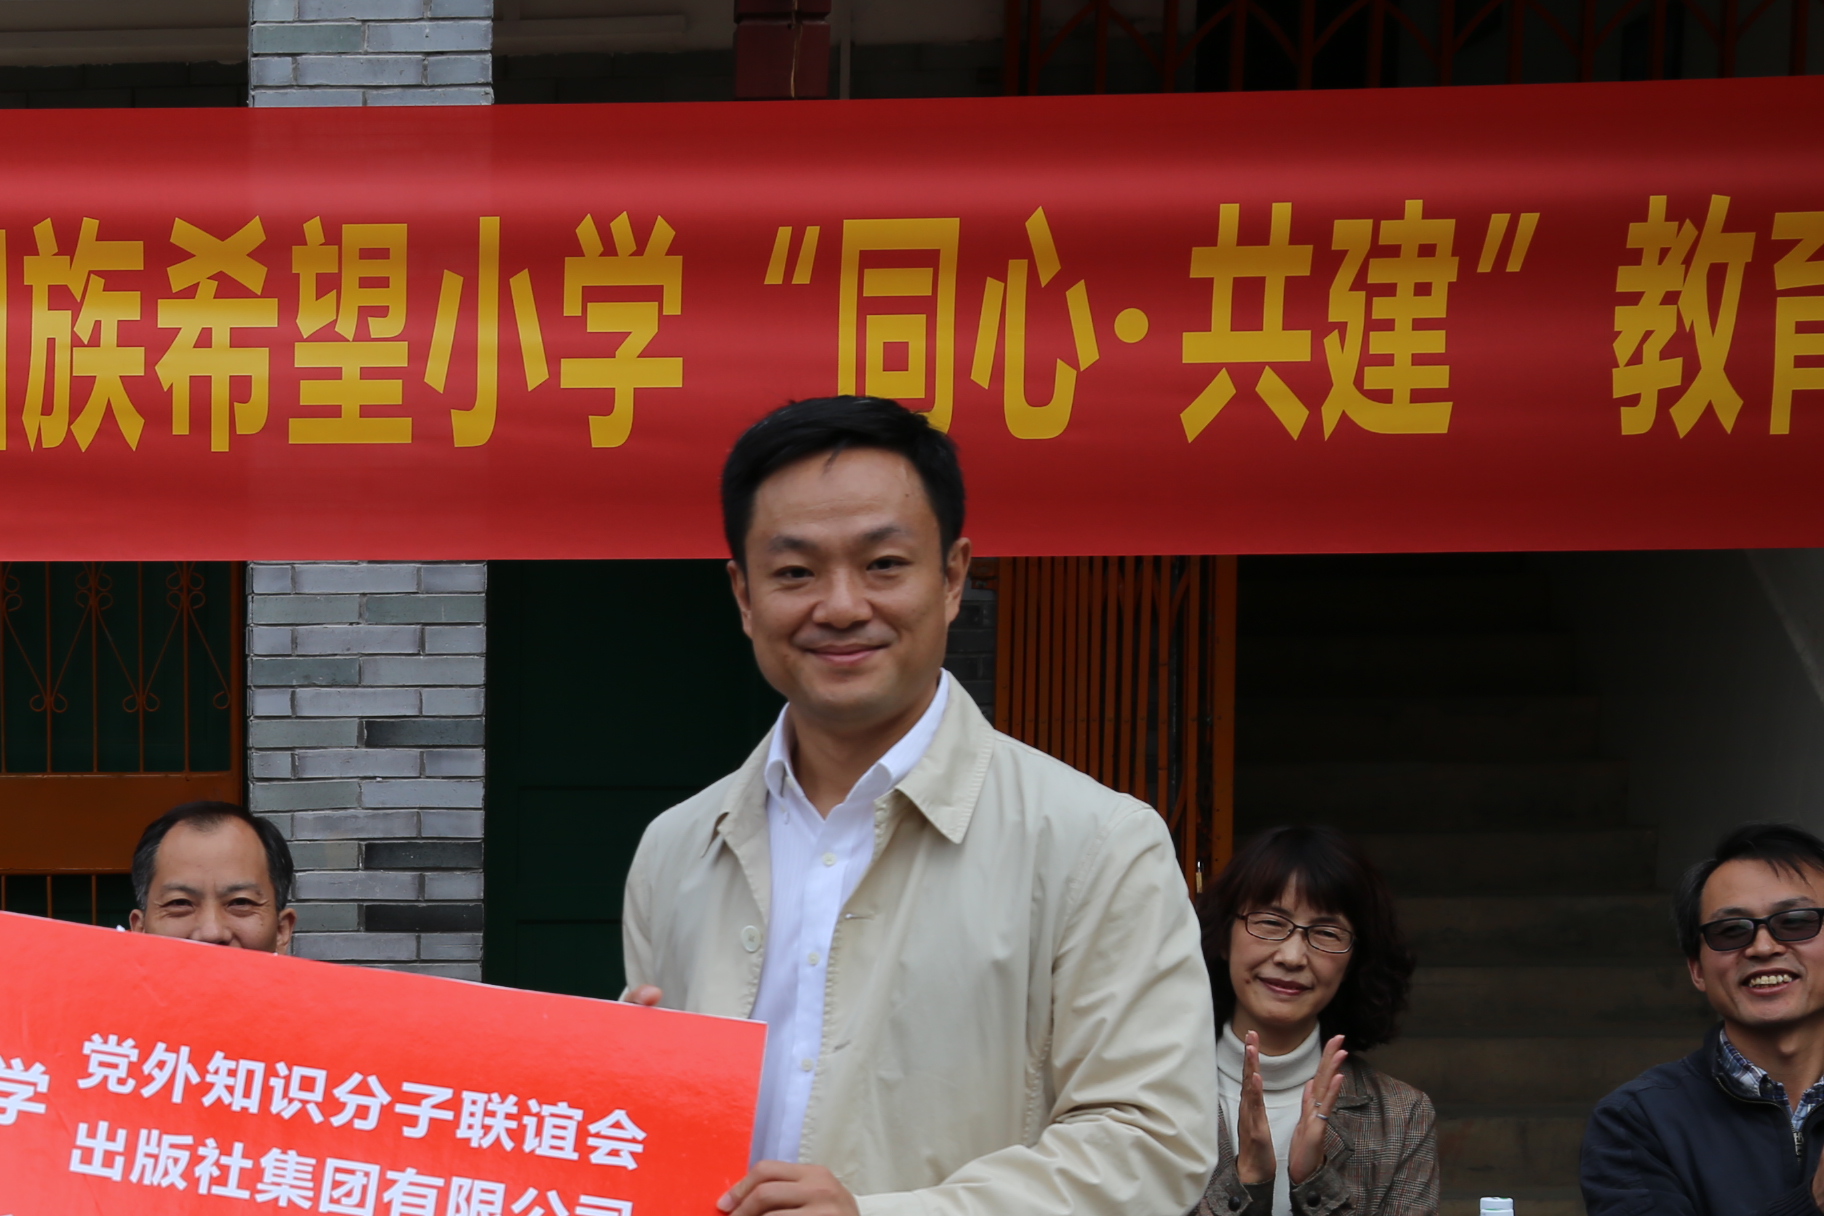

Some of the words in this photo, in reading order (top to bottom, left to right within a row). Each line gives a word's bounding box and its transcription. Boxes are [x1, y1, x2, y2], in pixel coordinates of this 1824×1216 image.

[76, 1032, 648, 1171] 党外知识分子联谊会
